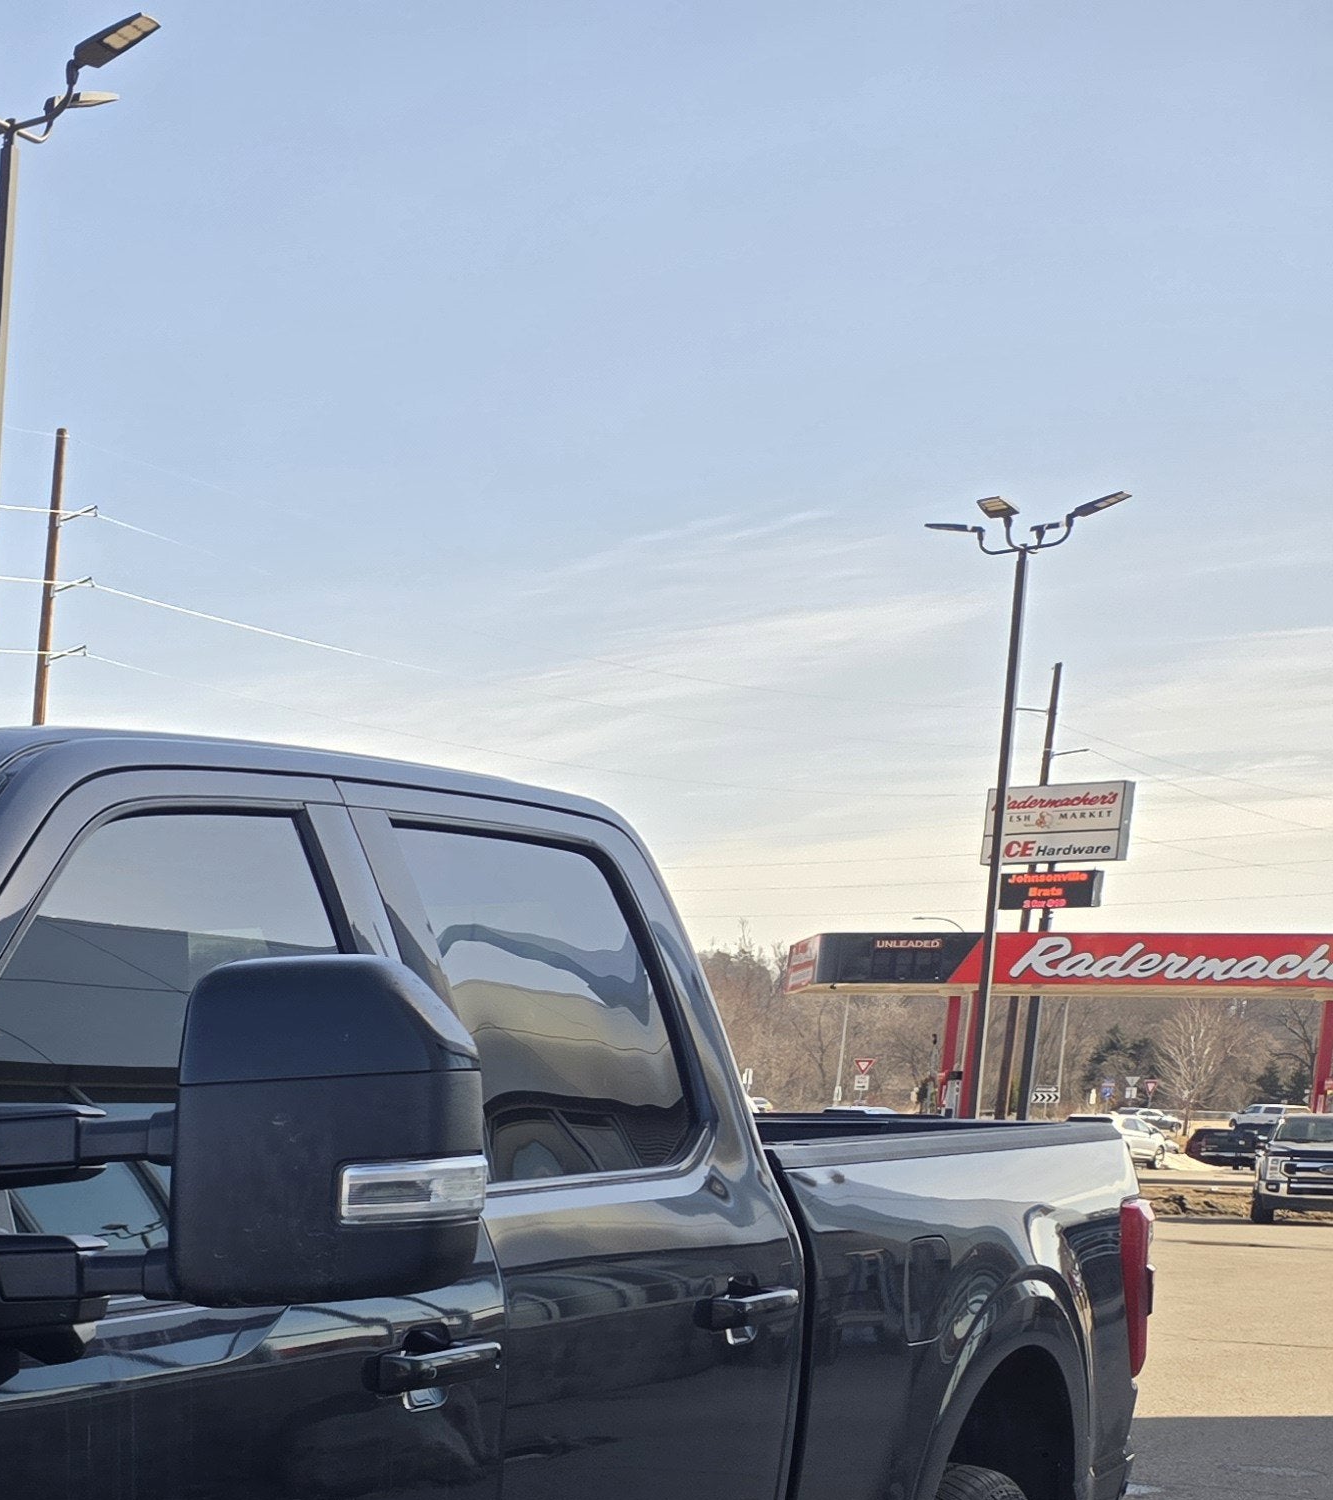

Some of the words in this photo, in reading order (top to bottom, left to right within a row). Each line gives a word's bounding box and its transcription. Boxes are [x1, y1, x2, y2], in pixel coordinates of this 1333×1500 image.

[1059, 810, 1113, 820] MARKET
[988, 840, 1036, 858] CE
[1035, 844, 1111, 857] Hardware
[876, 939, 941, 948] UNLEADED
[1009, 936, 1333, 981] Radermach
